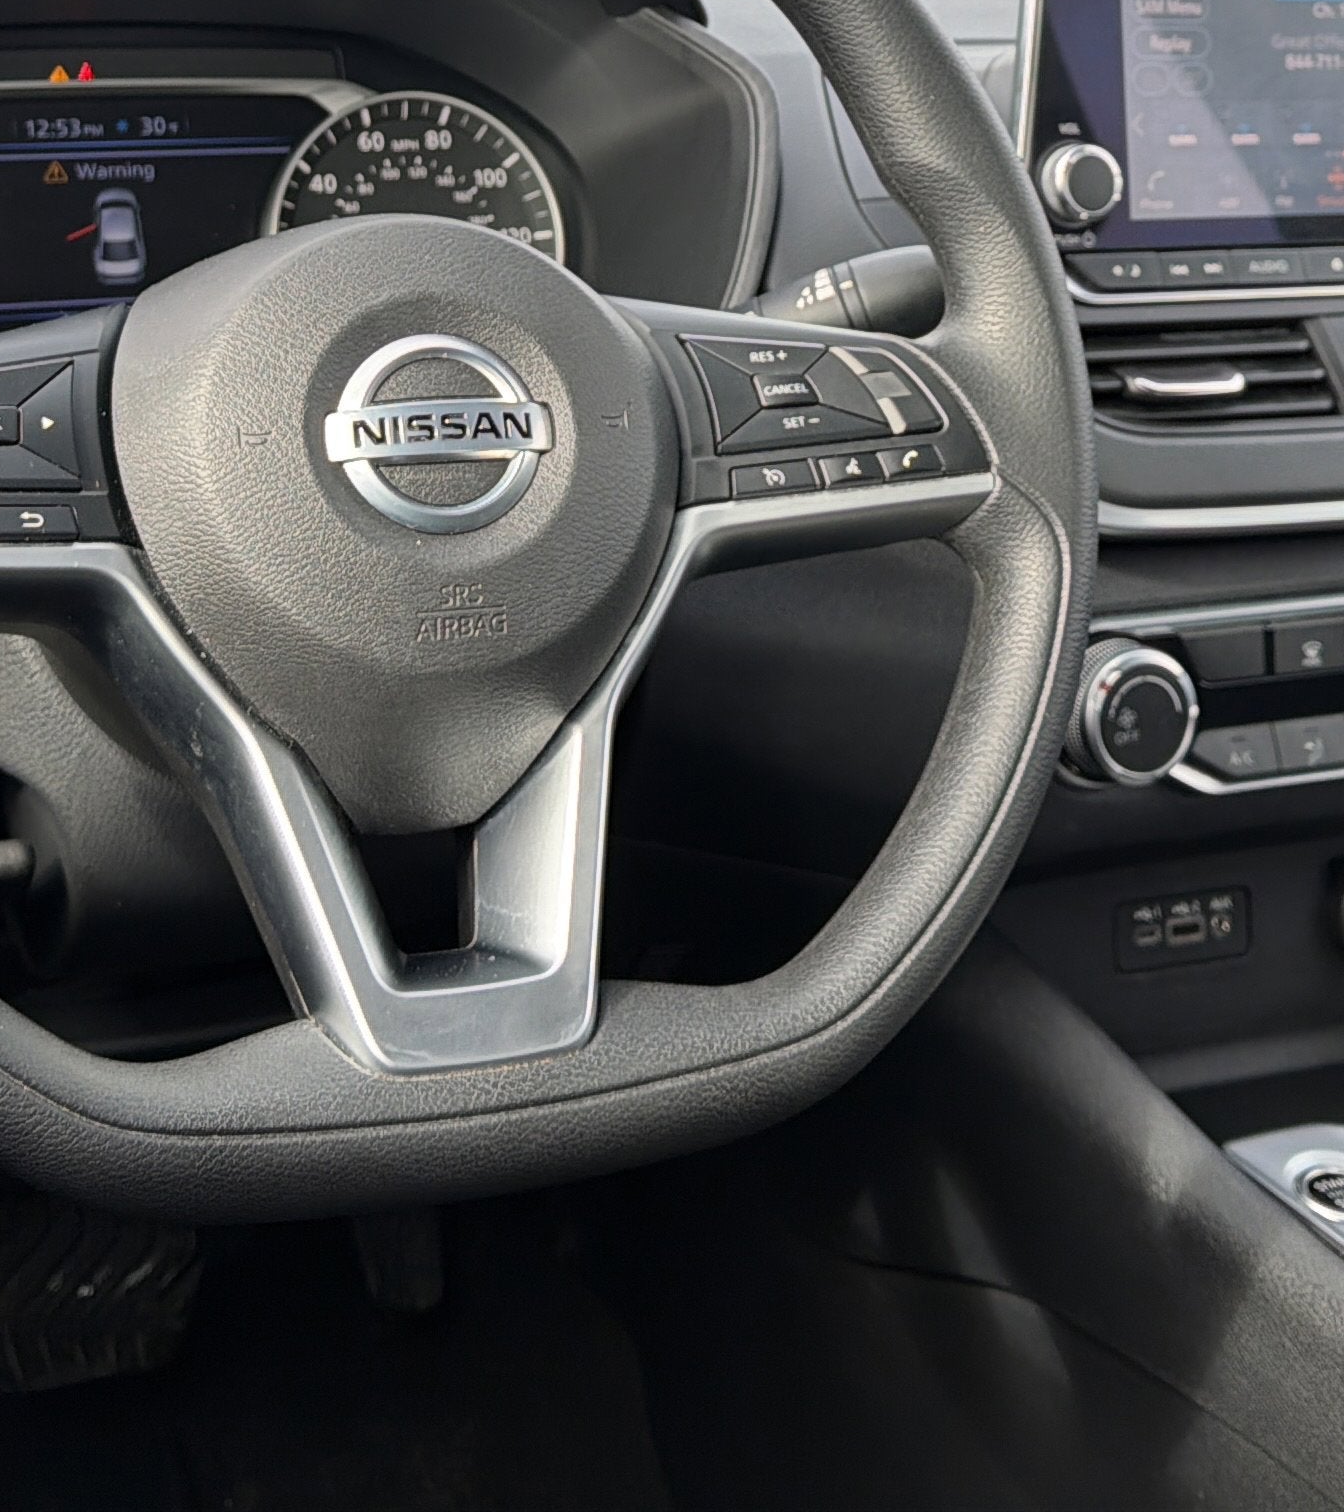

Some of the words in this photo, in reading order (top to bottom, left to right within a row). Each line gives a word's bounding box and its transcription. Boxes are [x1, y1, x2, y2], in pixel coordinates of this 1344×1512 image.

[24, 117, 81, 139] 12:53
[357, 130, 385, 153] 60
[424, 129, 453, 151] 80
[74, 161, 156, 183] Warning
[473, 167, 508, 189] 100
[308, 172, 338, 195] 40
[750, 349, 775, 364] RES
[763, 384, 809, 396] CANCEL
[354, 411, 533, 449] NISSAN
[782, 417, 806, 431] SET
[439, 583, 483, 606] SRS
[415, 613, 508, 643] AIRBAG
